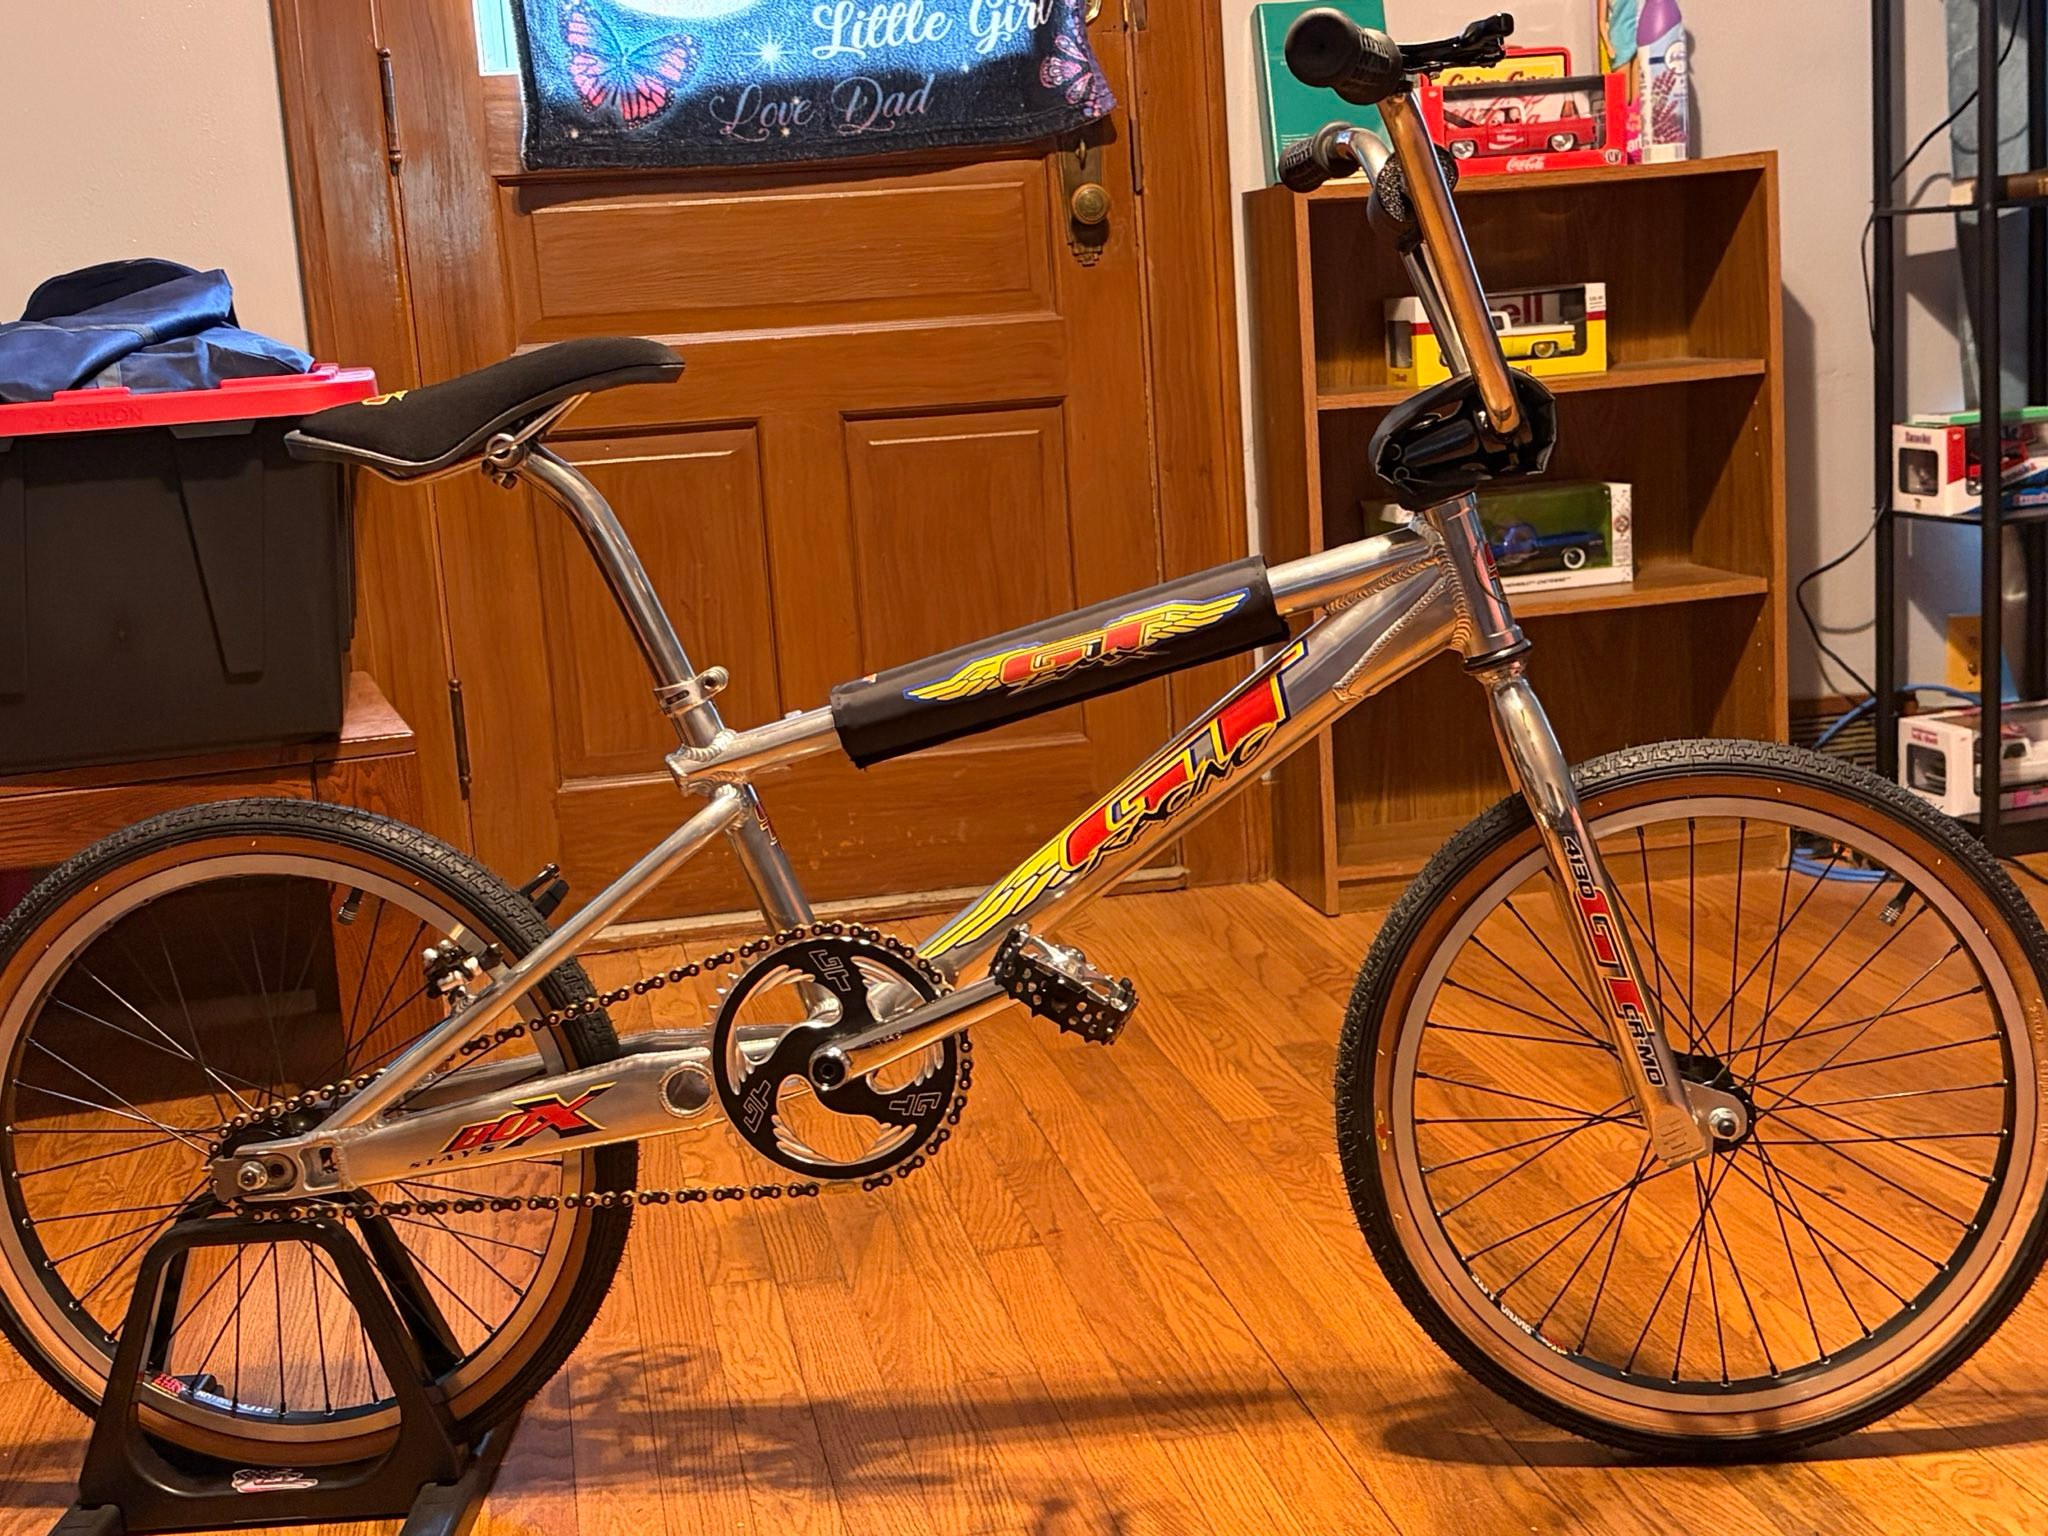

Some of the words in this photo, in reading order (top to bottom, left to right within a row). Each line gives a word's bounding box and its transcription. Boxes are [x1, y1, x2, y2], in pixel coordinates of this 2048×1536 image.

[812, 0, 951, 59] Little
[968, 0, 1051, 54] Girl
[709, 83, 818, 142] Love
[830, 73, 934, 136] Dad
[1563, 835, 1597, 899] 4130
[808, 948, 852, 992] GT
[439, 1081, 618, 1154] BOX
[888, 1091, 942, 1117] GT
[409, 1144, 496, 1168] STAYS
